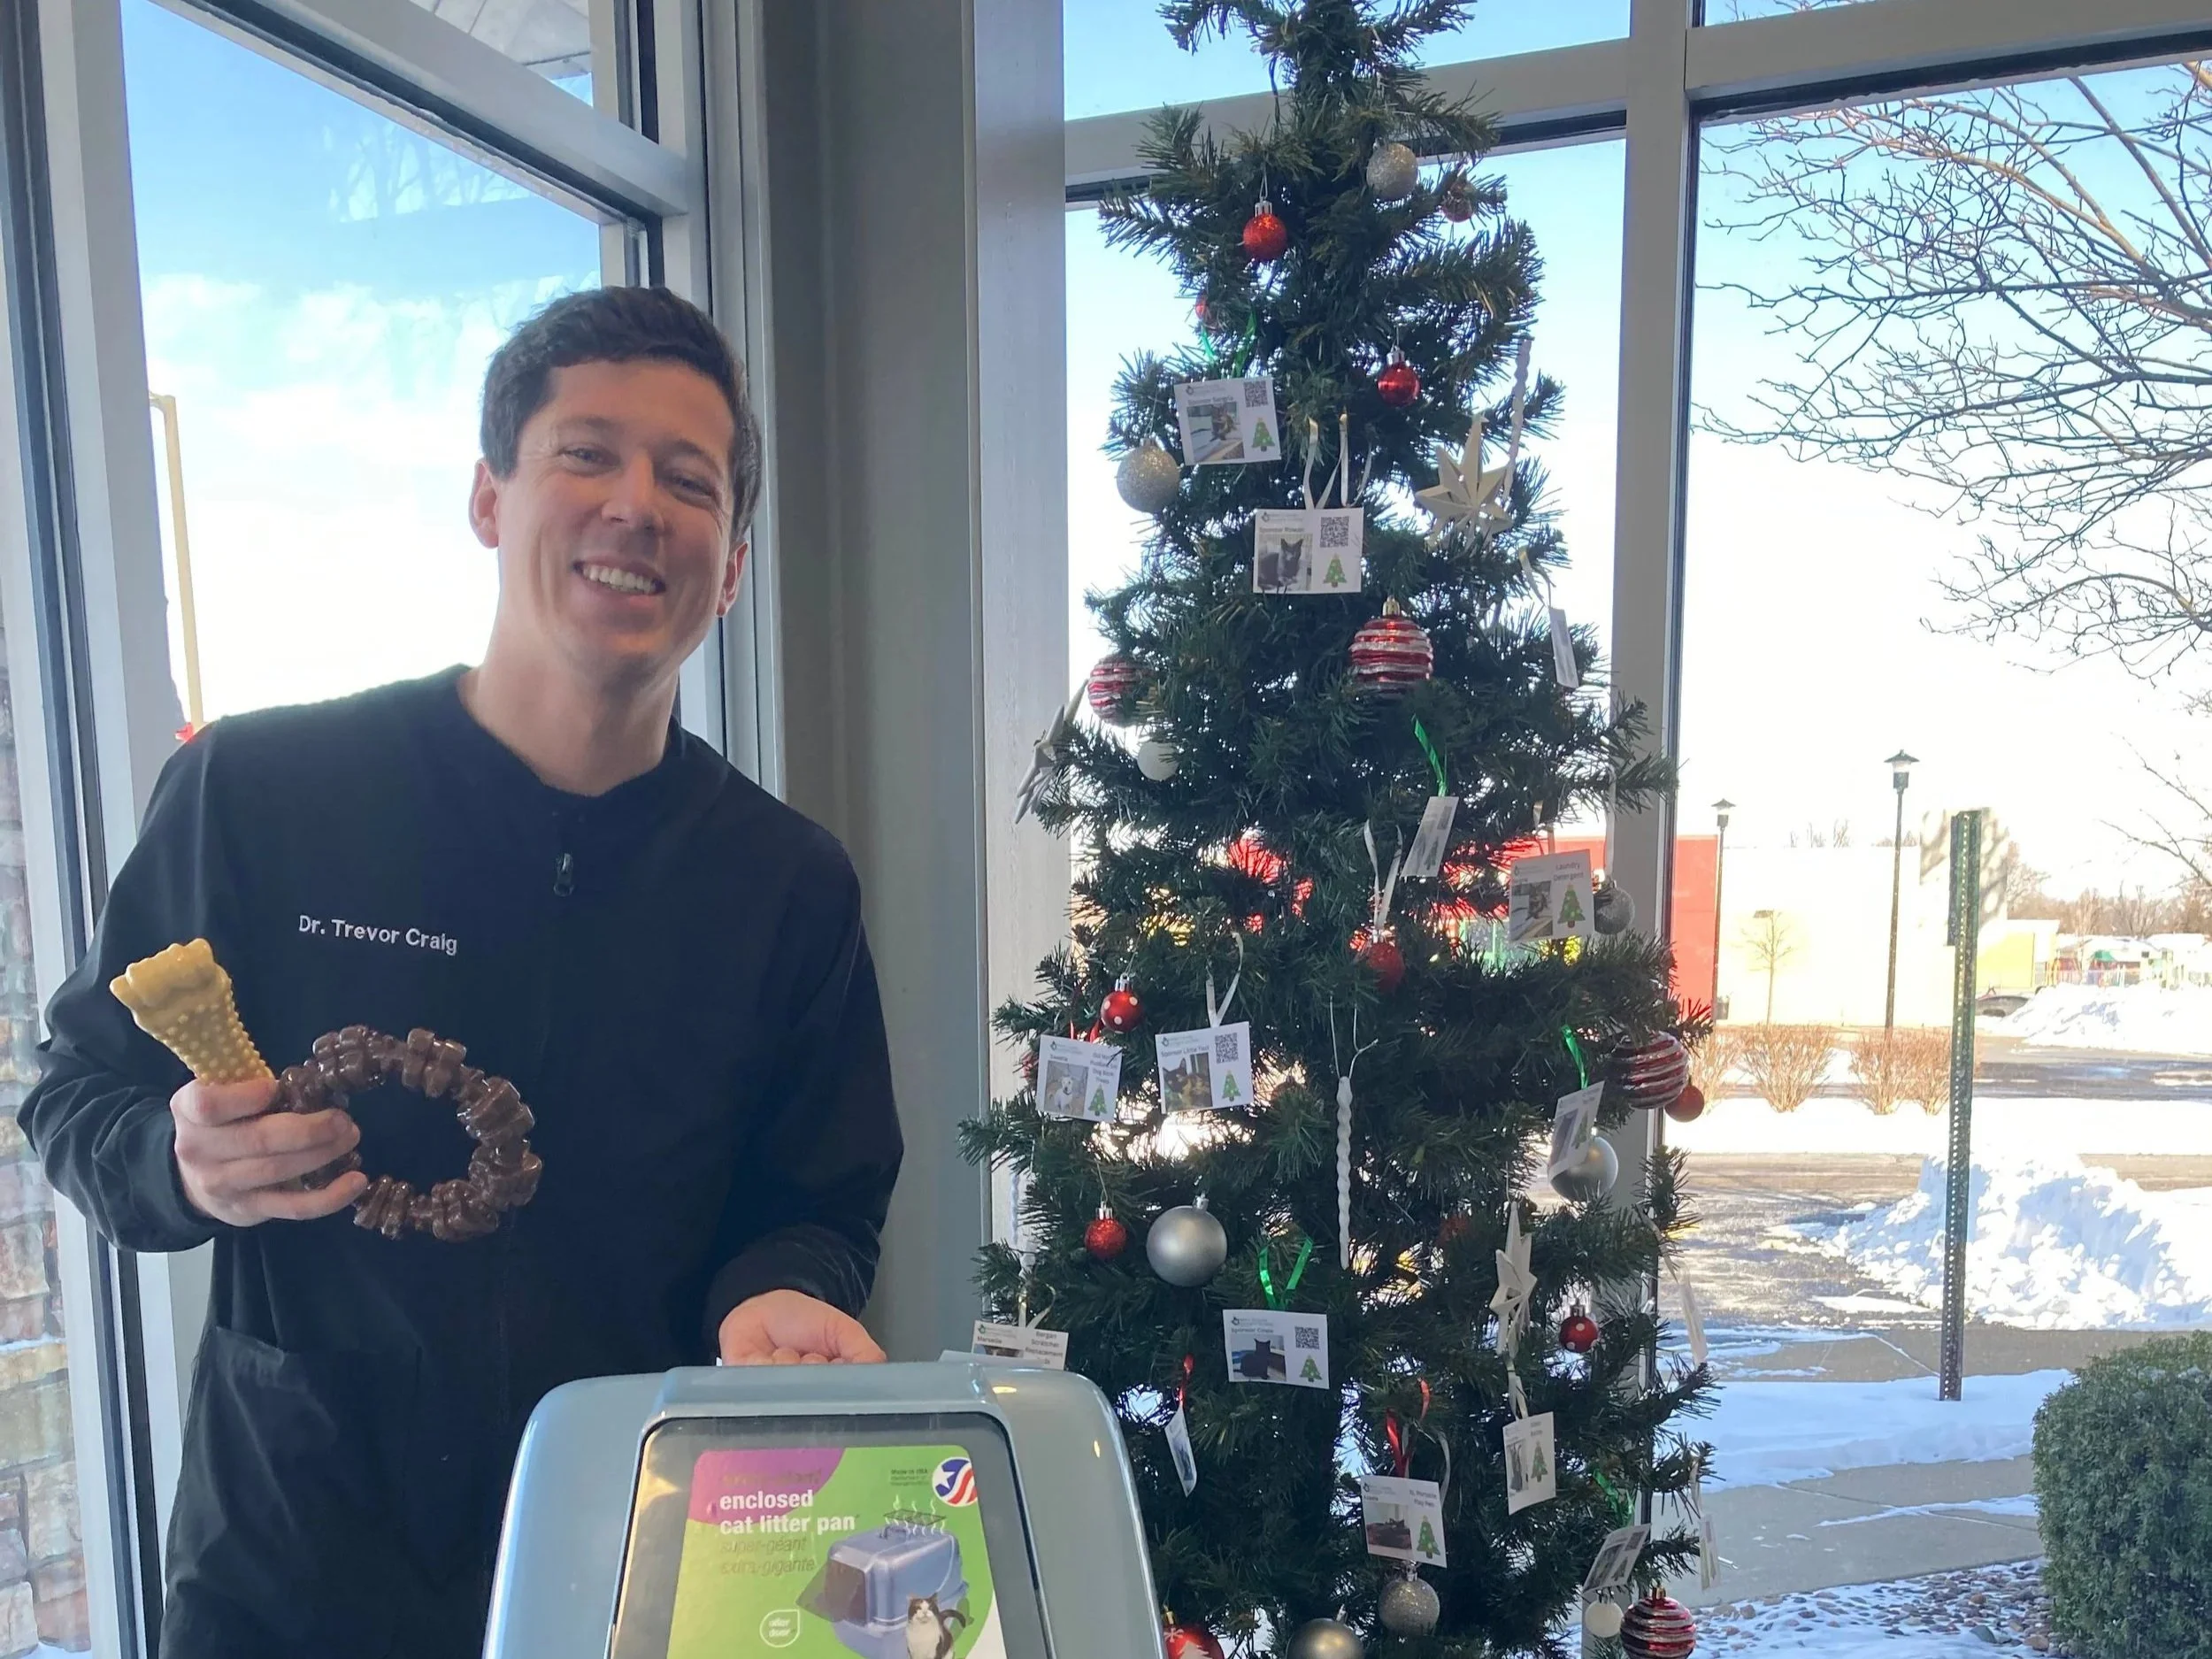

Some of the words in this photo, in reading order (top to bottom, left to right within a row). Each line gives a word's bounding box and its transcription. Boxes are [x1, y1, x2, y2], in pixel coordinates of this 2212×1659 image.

[299, 915, 325, 934] Dr.
[331, 919, 400, 944] Trevor
[405, 928, 457, 956] Craig
[719, 1490, 814, 1510] enclosed
[719, 1518, 753, 1534] cat
[759, 1515, 809, 1533] litter
[817, 1517, 856, 1534] pan
